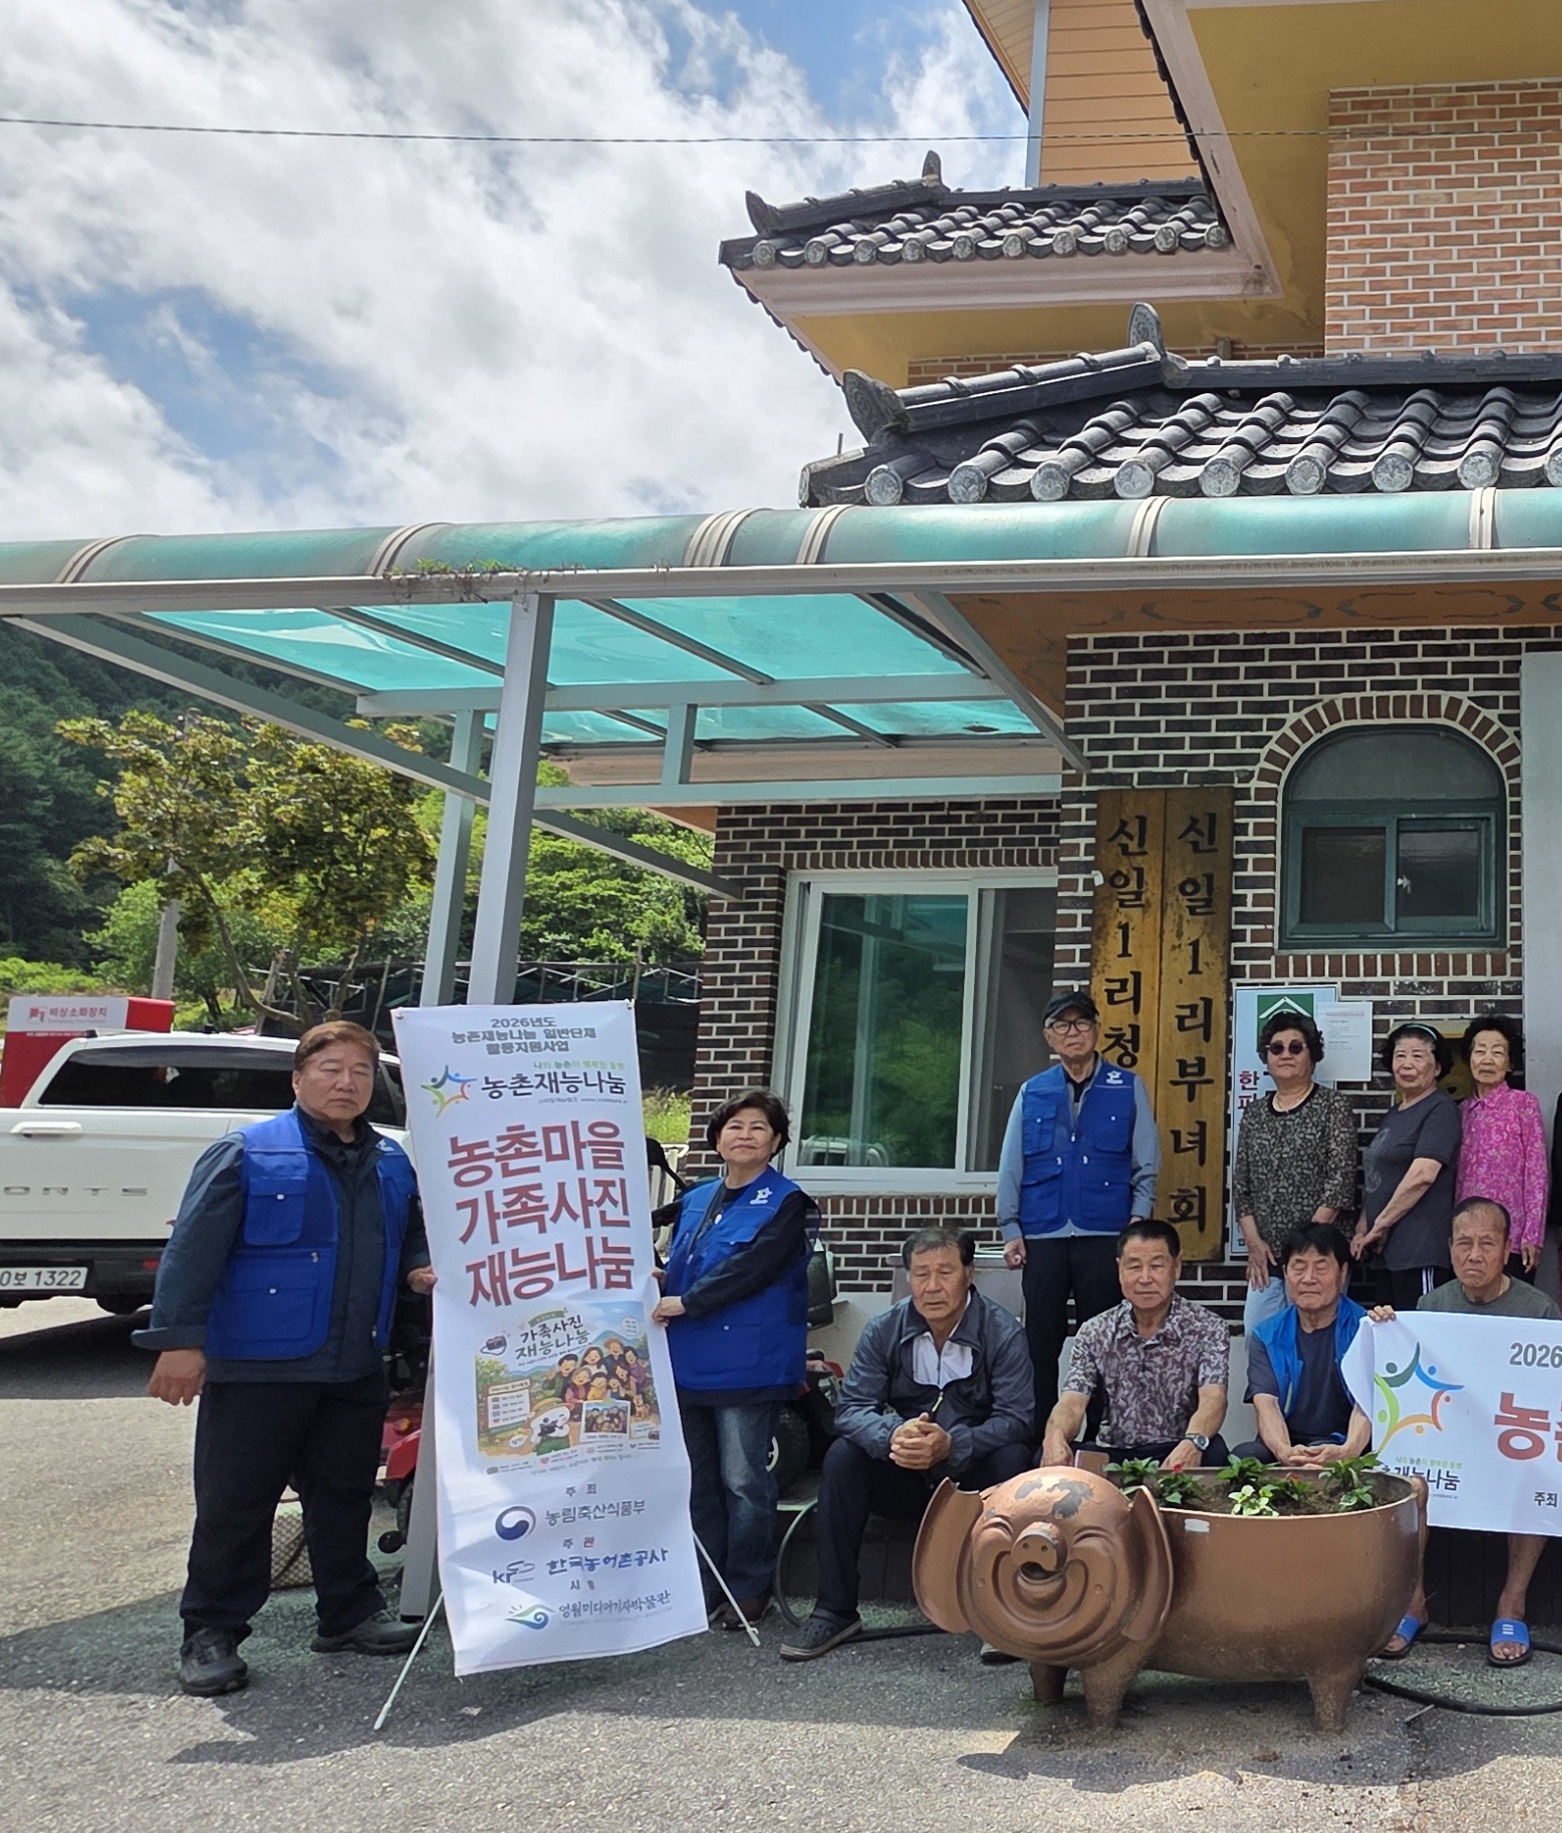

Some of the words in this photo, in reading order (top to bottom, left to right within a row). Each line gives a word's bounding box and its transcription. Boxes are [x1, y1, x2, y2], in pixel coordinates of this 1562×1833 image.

[50, 1006, 108, 1018] 비상소화장치
[490, 1017, 557, 1028] 2026년도
[1167, 812, 1219, 1233] 신일1리부녀회
[543, 1028, 597, 1039] 일반단체
[486, 1041, 569, 1055] 활동지원사업
[481, 1070, 627, 1100] 농촌재능나눔
[448, 1120, 625, 1188] 농촌마을
[455, 1177, 631, 1245] 가족사진
[35, 1270, 82, 1286] 1322
[465, 1236, 635, 1307] 재능나눔
[520, 1314, 584, 1345] 가족사진
[1534, 1491, 1558, 1507] 주최
[545, 1500, 646, 1526] 농림축산식품부
[546, 1547, 669, 1575] 한국농어촌공사
